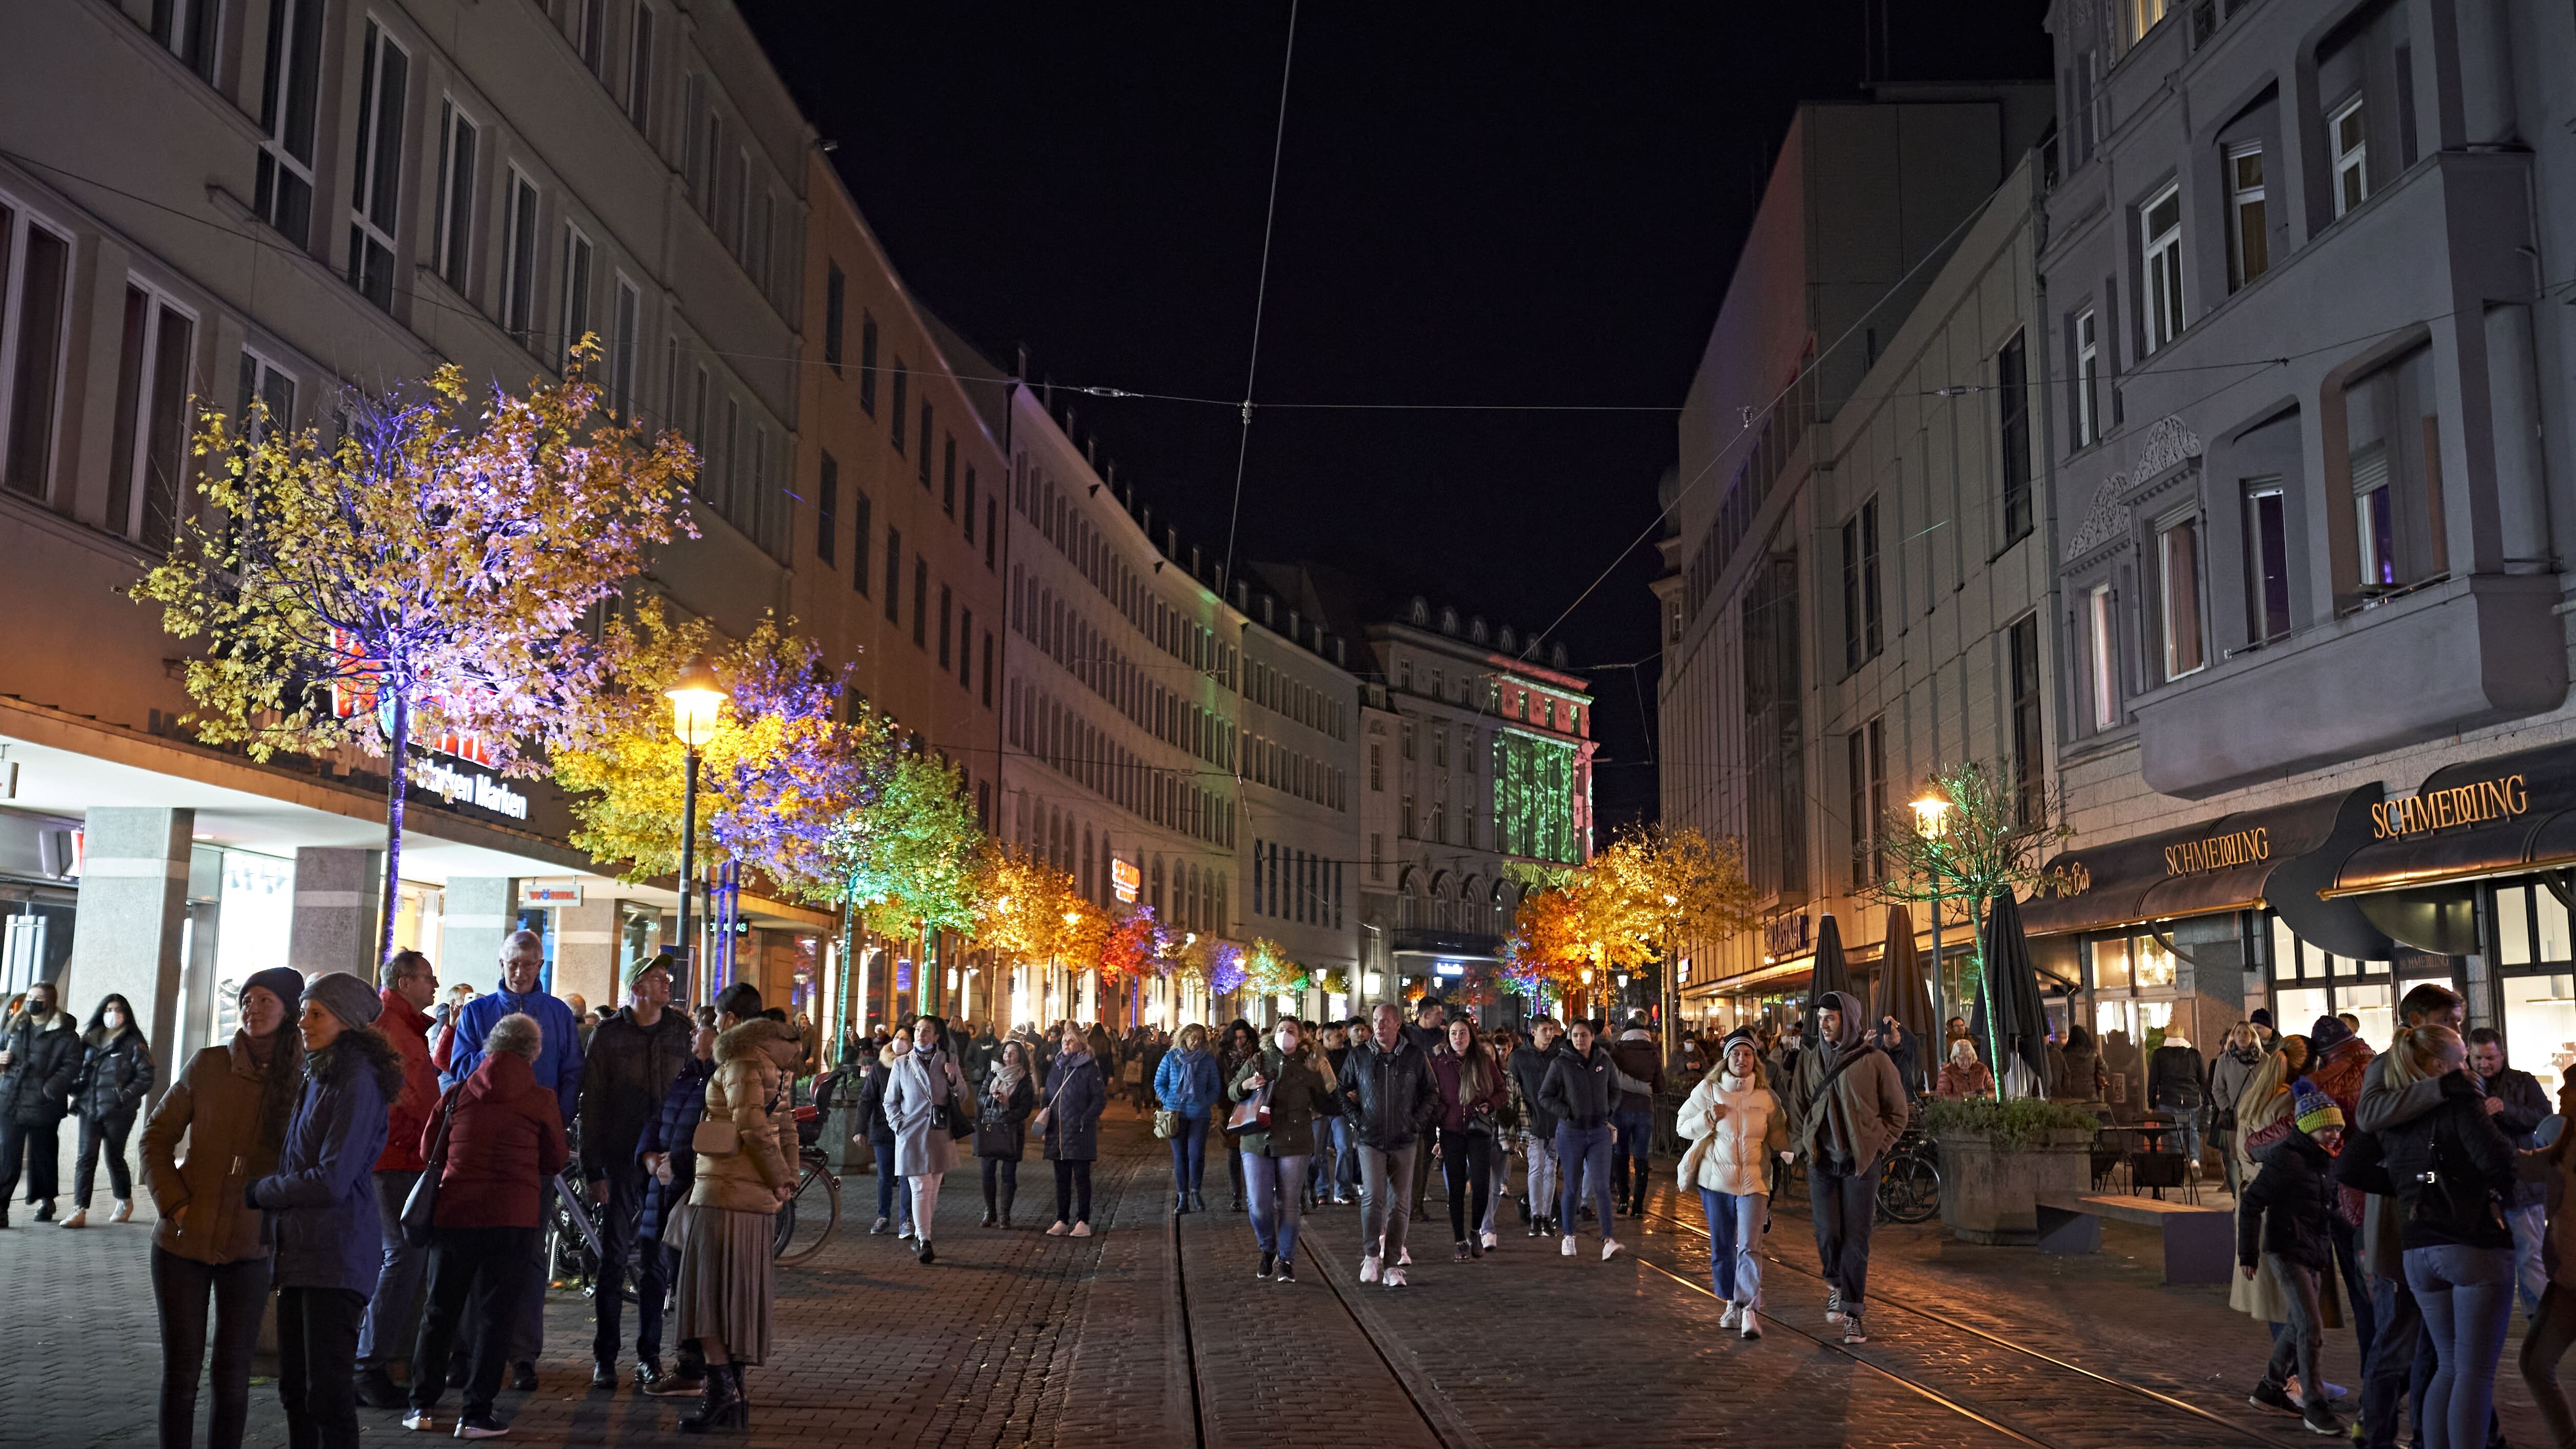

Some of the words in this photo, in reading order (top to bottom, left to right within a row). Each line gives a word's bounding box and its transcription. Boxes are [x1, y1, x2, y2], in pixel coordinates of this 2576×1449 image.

[475, 773, 527, 820] Marken
[2371, 774, 2527, 839] SCHMEDDING
[2165, 827, 2269, 876] SCHMEDDING
[2072, 862, 2090, 896] Bar
[2400, 954, 2449, 971] HMEDDING
